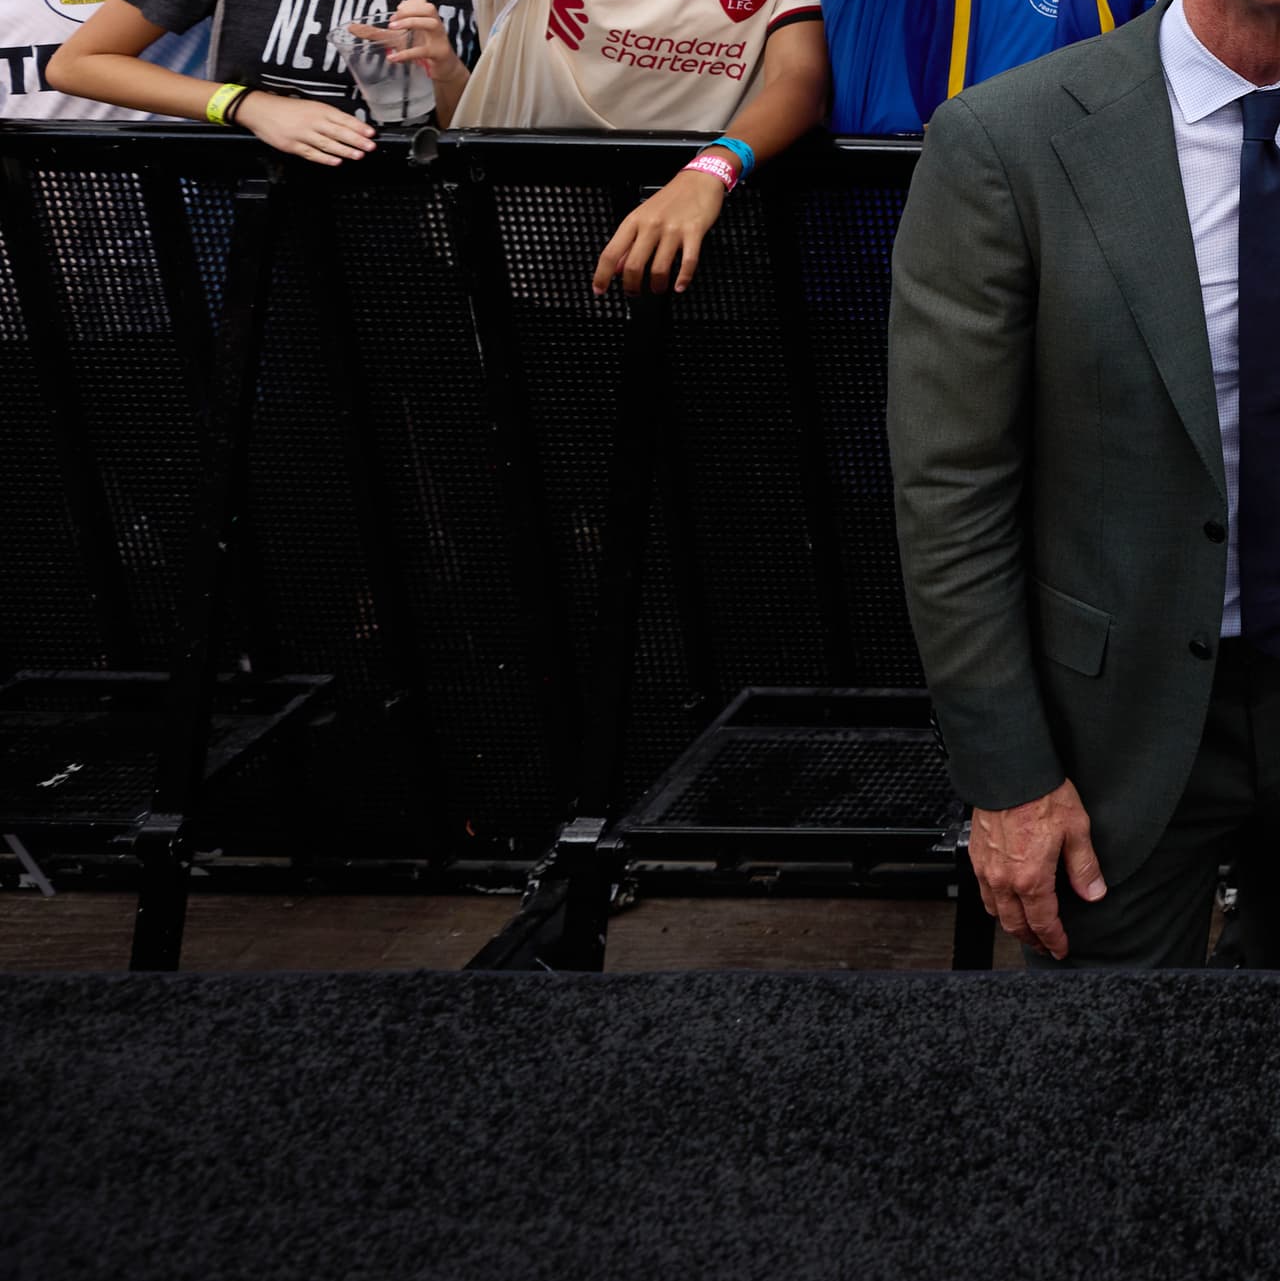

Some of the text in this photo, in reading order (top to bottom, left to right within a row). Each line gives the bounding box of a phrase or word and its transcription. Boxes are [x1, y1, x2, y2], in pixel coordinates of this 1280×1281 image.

[604, 27, 747, 60] standard
[600, 45, 747, 81] chartered
[699, 156, 733, 173] GUEST
